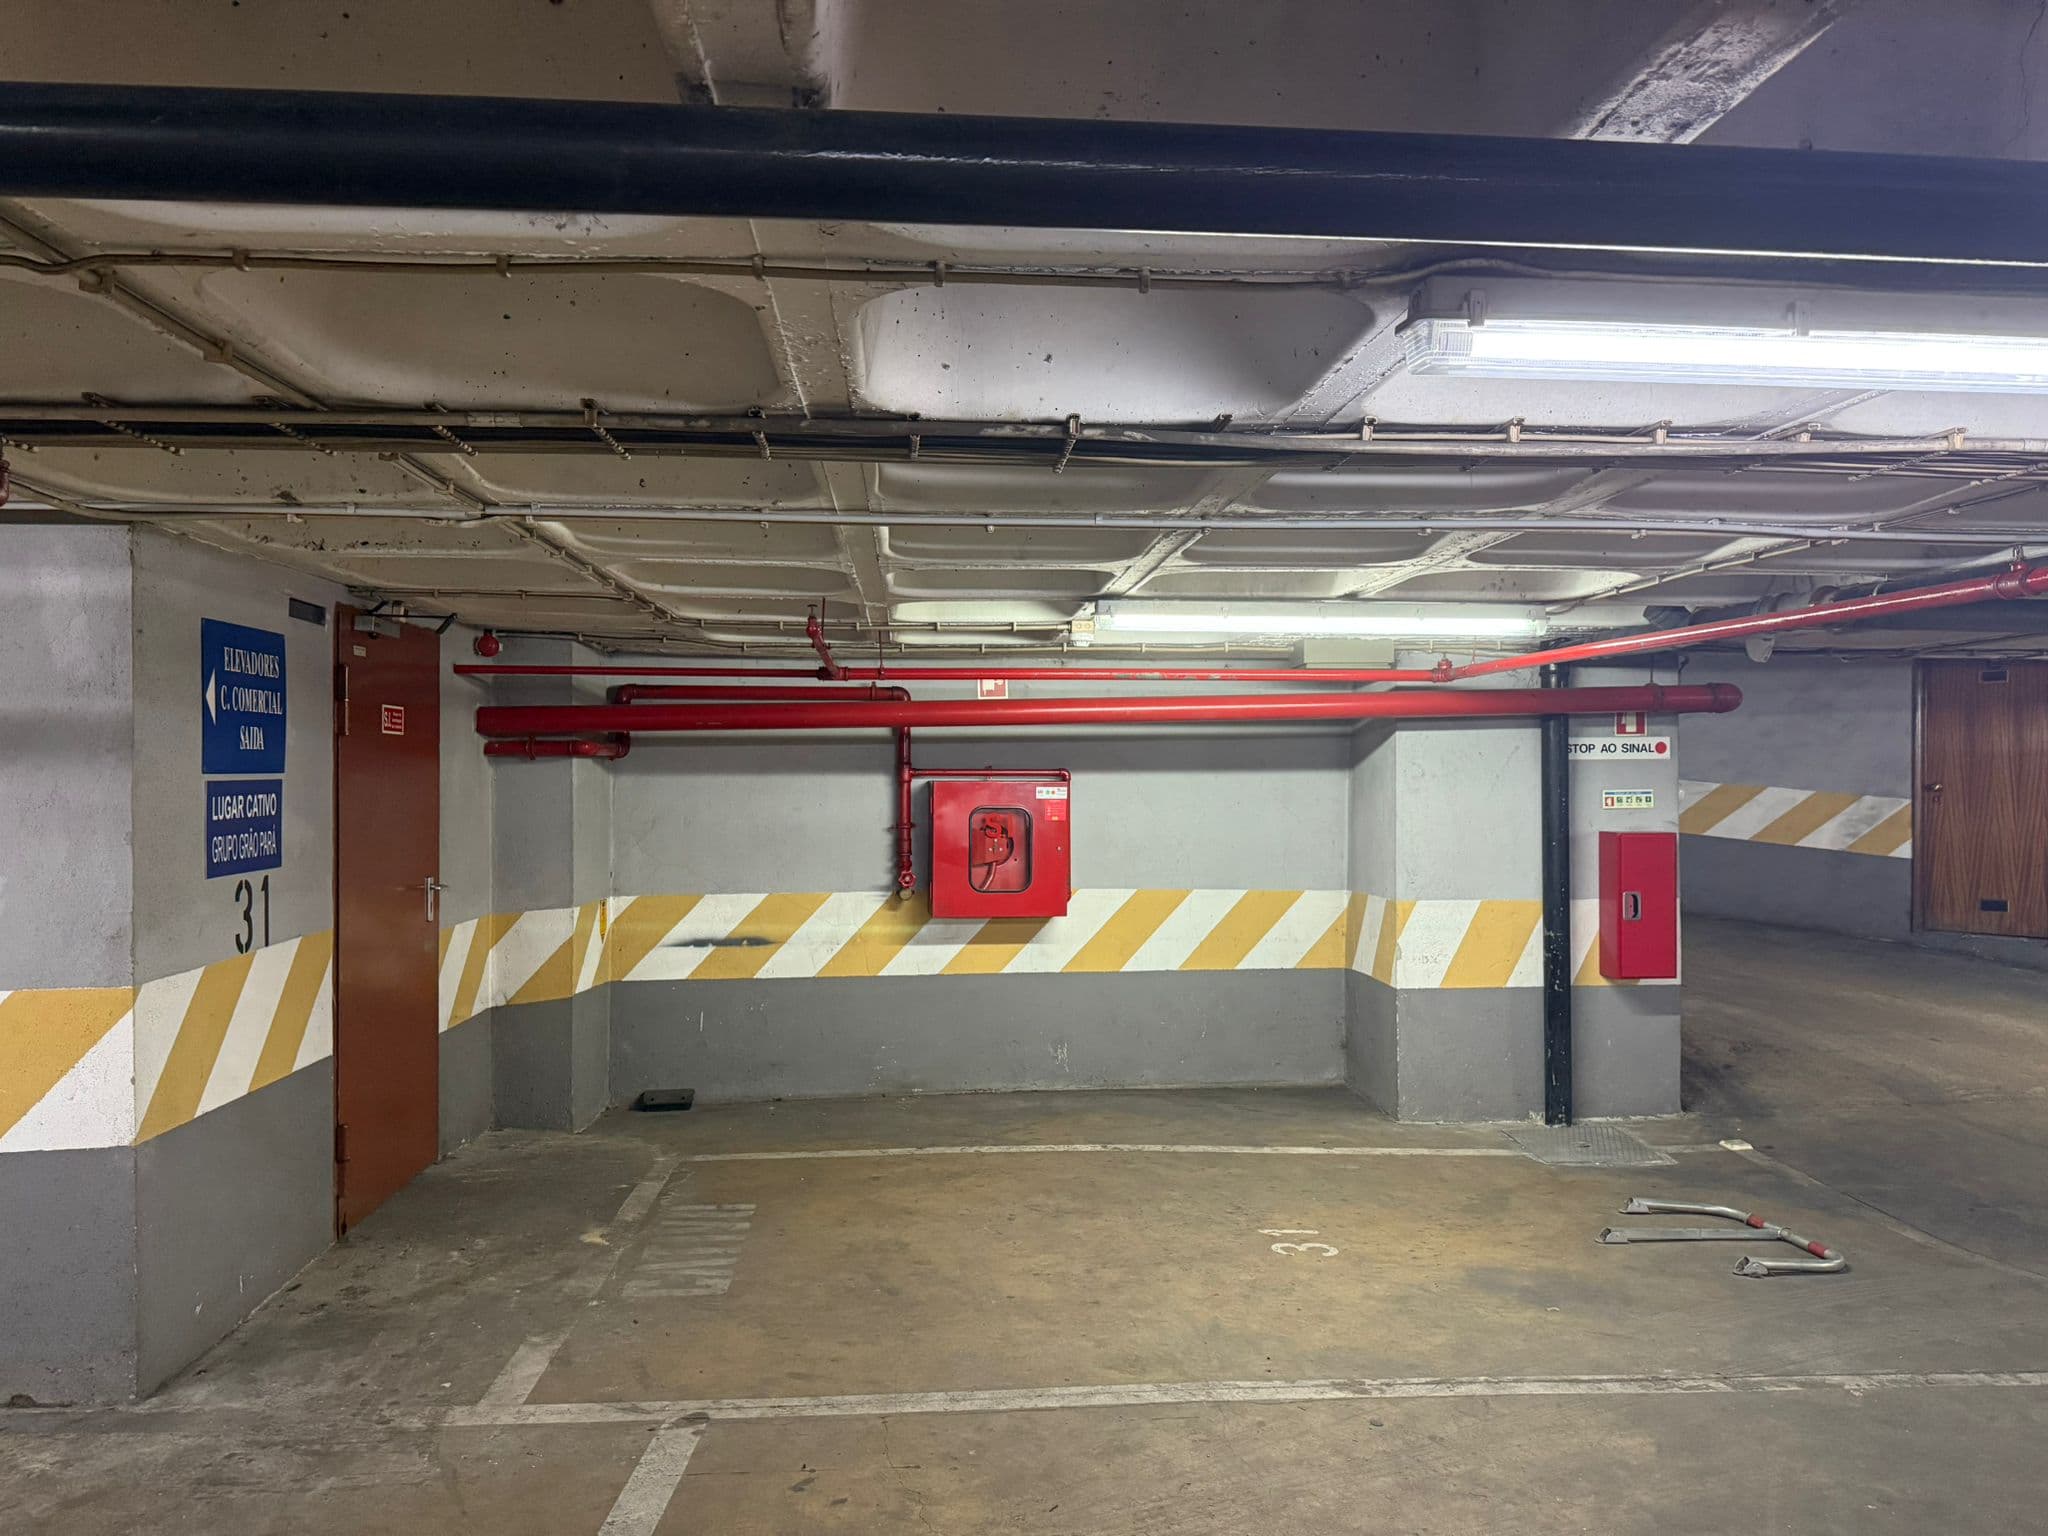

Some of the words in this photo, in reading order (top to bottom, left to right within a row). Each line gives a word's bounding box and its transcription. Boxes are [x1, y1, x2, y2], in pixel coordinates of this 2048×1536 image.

[223, 646, 280, 679] ELEVADORES
[221, 684, 231, 711] C.
[232, 686, 283, 715] COMERCIAL
[239, 725, 265, 750] SAIDA
[1600, 742, 1617, 754] AO
[1621, 743, 1655, 754] SINAL
[211, 795, 245, 821] LUGAR
[246, 793, 277, 818] CATIVO
[211, 835, 239, 864] GRUPO
[260, 824, 277, 857] PARÁ
[234, 874, 270, 955] 31
[1257, 1229, 1339, 1256] 31
